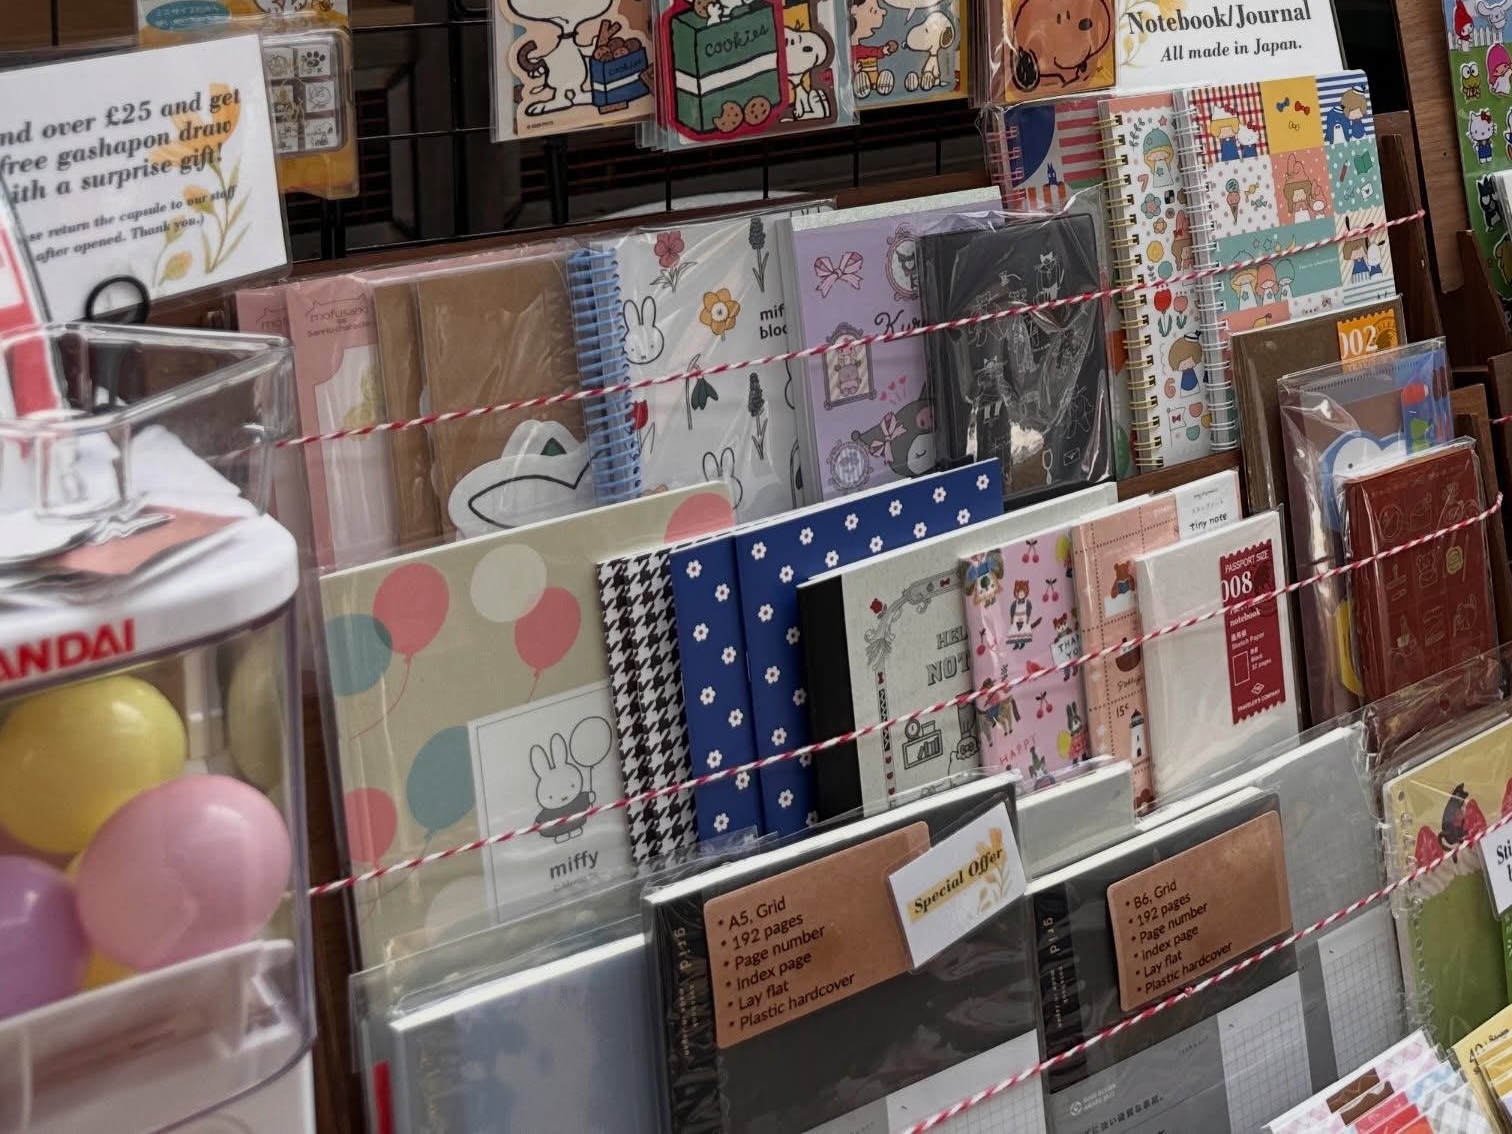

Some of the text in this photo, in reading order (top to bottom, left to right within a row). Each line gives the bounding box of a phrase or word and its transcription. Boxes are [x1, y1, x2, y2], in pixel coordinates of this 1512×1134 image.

[1127, 0, 1312, 35] Notebook/Journal
[704, 24, 770, 58] cookies
[1160, 38, 1302, 62] All made in Japan.
[42, 116, 96, 139] over
[105, 100, 152, 128] £25
[161, 91, 202, 117] and
[209, 88, 240, 114] get
[0, 154, 48, 176] free
[57, 132, 170, 171] gashapon
[179, 118, 232, 143] draw
[11, 143, 223, 204] ith a surprise gift!
[48, 185, 237, 238] return the capsule to our staff
[36, 215, 205, 263] after opened. Thank you.)
[1189, 512, 1227, 533] tiny note
[1225, 548, 1269, 575] PASSPORT SIZE
[1229, 609, 1262, 628] notebook
[0, 619, 136, 686] ANDAI
[1000, 733, 1037, 765] HAPPY
[549, 849, 599, 882] miffy
[913, 847, 1004, 916] Special Offer
[1133, 879, 1177, 909] B6, Grid
[1136, 892, 1191, 927] 192 pages
[728, 896, 787, 932] A5, Grid
[733, 914, 804, 952] 192 pages
[1140, 901, 1209, 947] Page number
[674, 926, 692, 971] grid
[734, 925, 826, 975] Page number
[1043, 917, 1060, 956] grid
[1142, 926, 1199, 962] Index page
[736, 952, 812, 992] Index page
[1144, 951, 1183, 980] Lay flat
[1145, 940, 1233, 993] Plastic hardcover
[738, 979, 790, 1014] Lay flat
[739, 972, 856, 1031] Plastic hardcover
